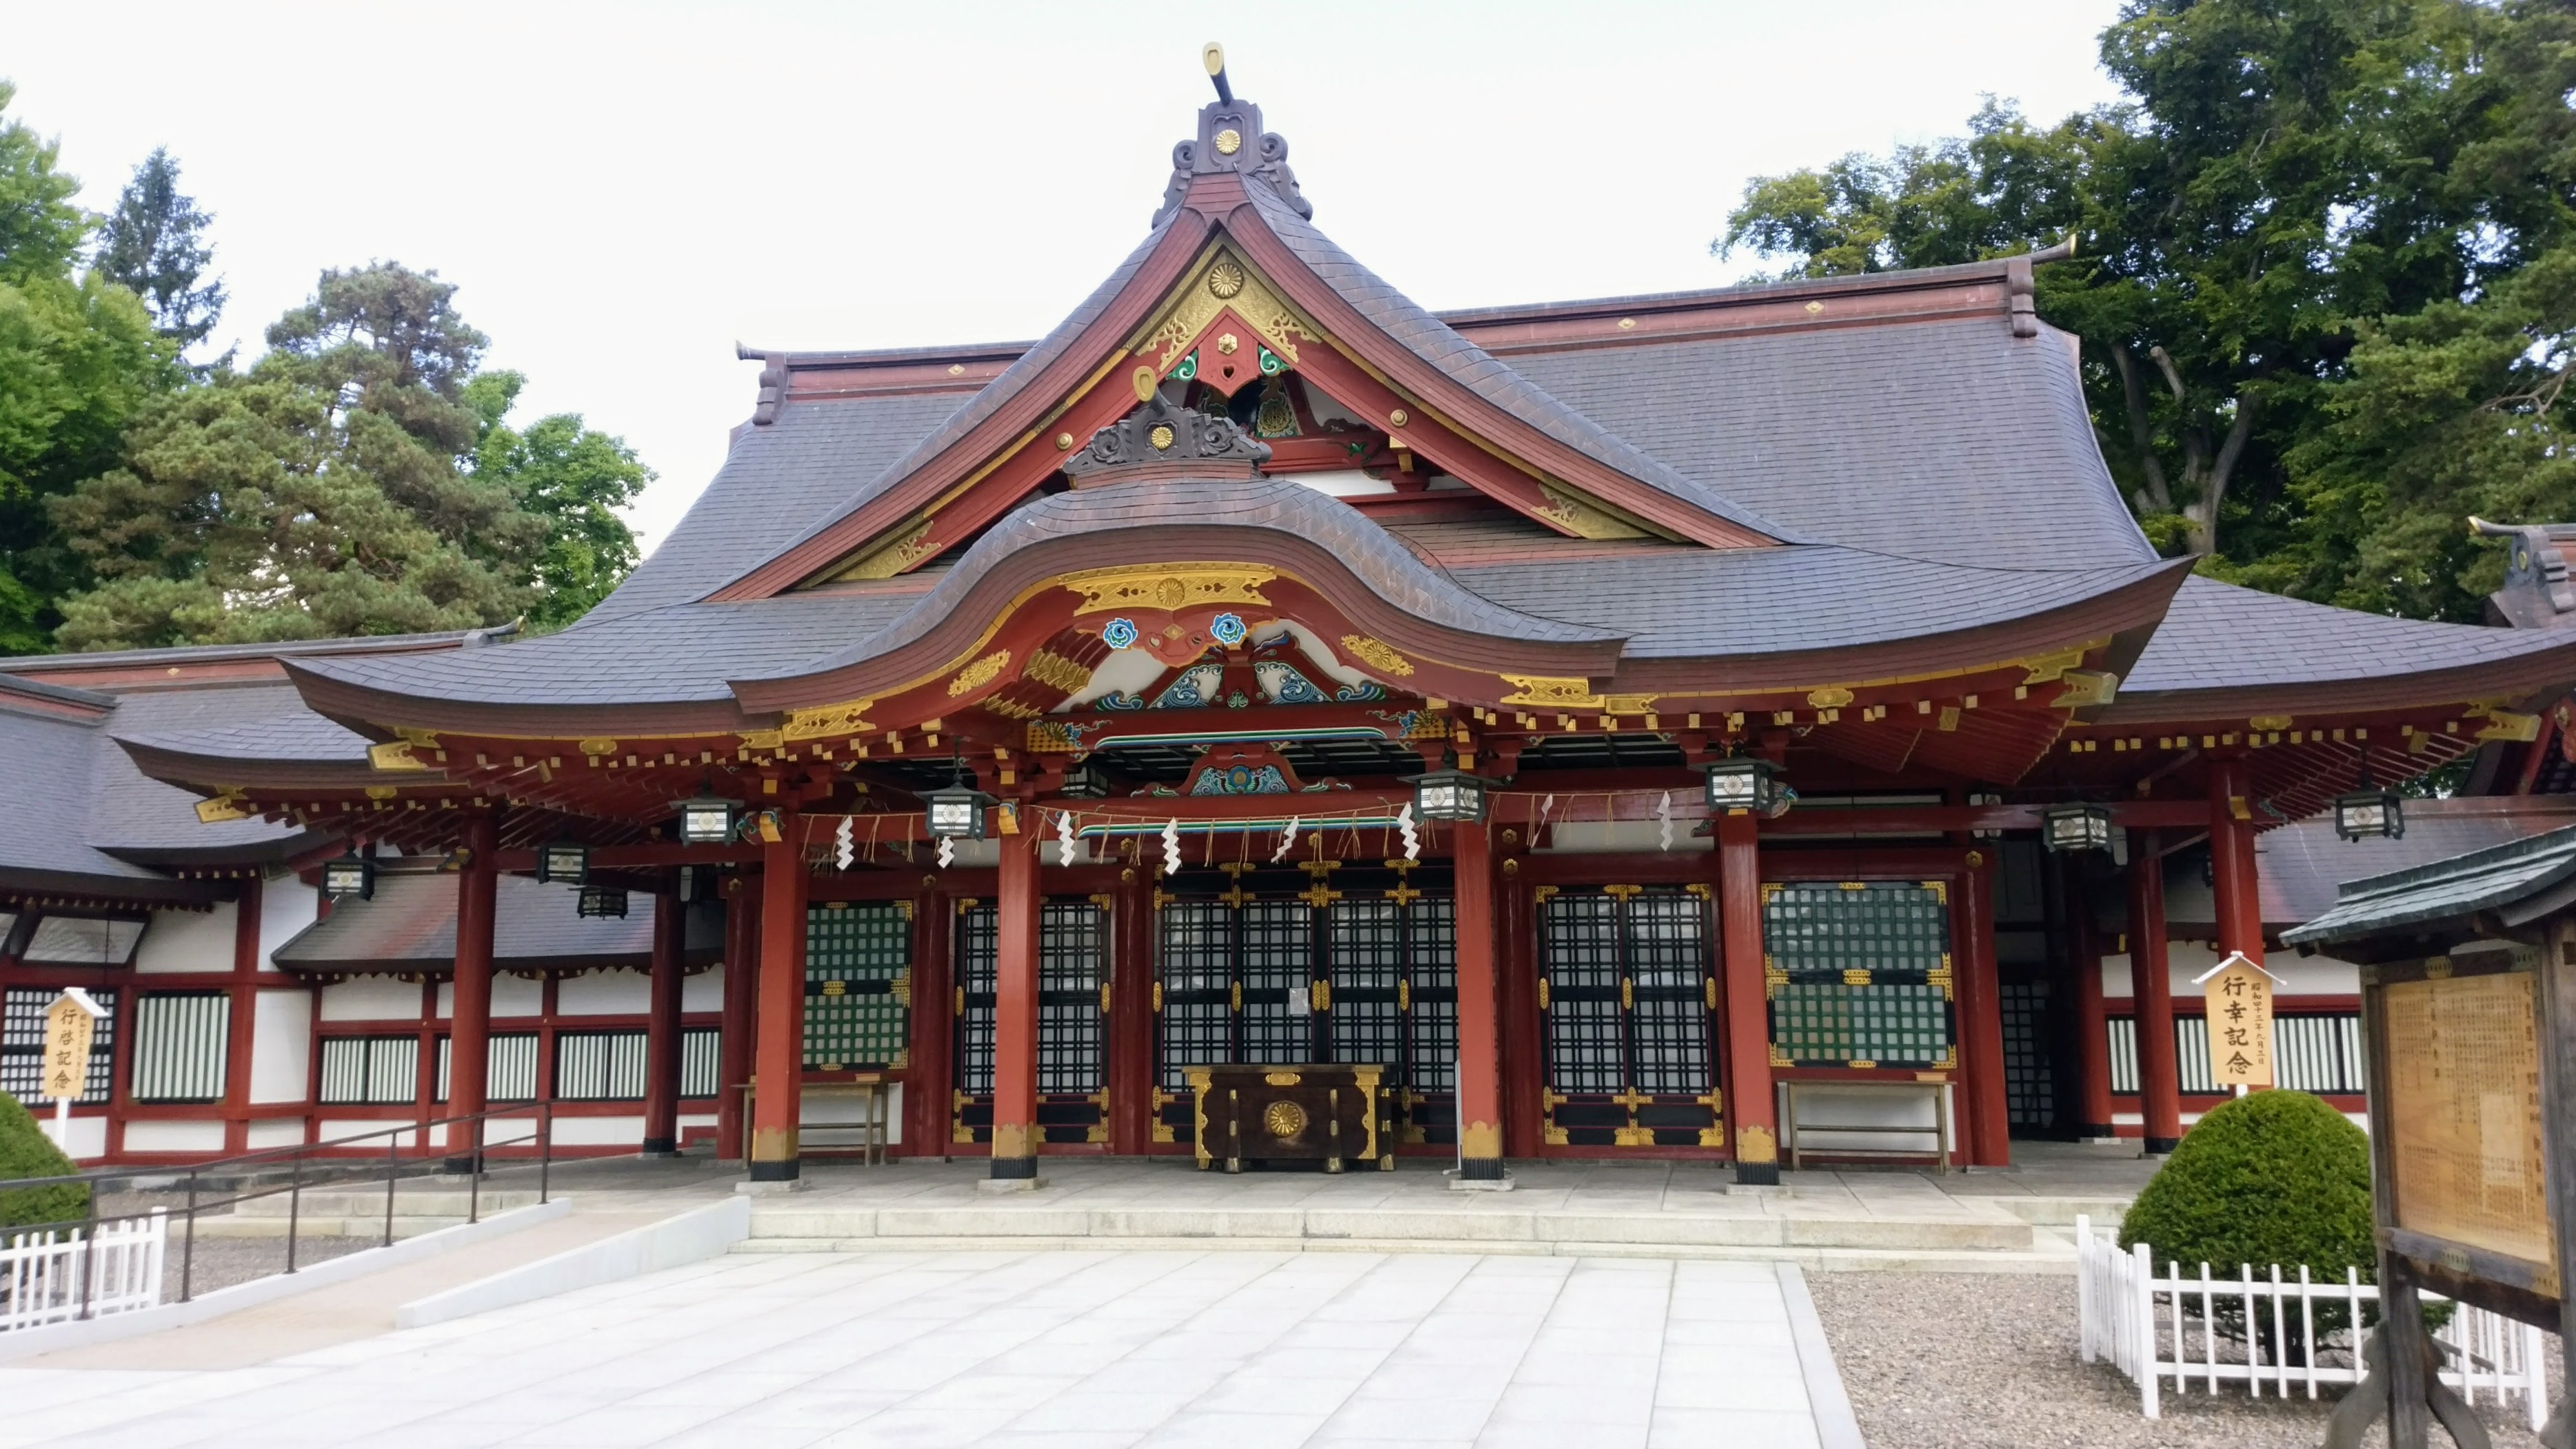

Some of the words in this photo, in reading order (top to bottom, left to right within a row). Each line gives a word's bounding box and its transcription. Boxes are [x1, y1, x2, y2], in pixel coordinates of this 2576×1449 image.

[54, 1008, 77, 1089] 行啓記念
[2222, 977, 2253, 1075] 行幸記念
[2251, 982, 2266, 1065] 昭和四十三年九月三日
